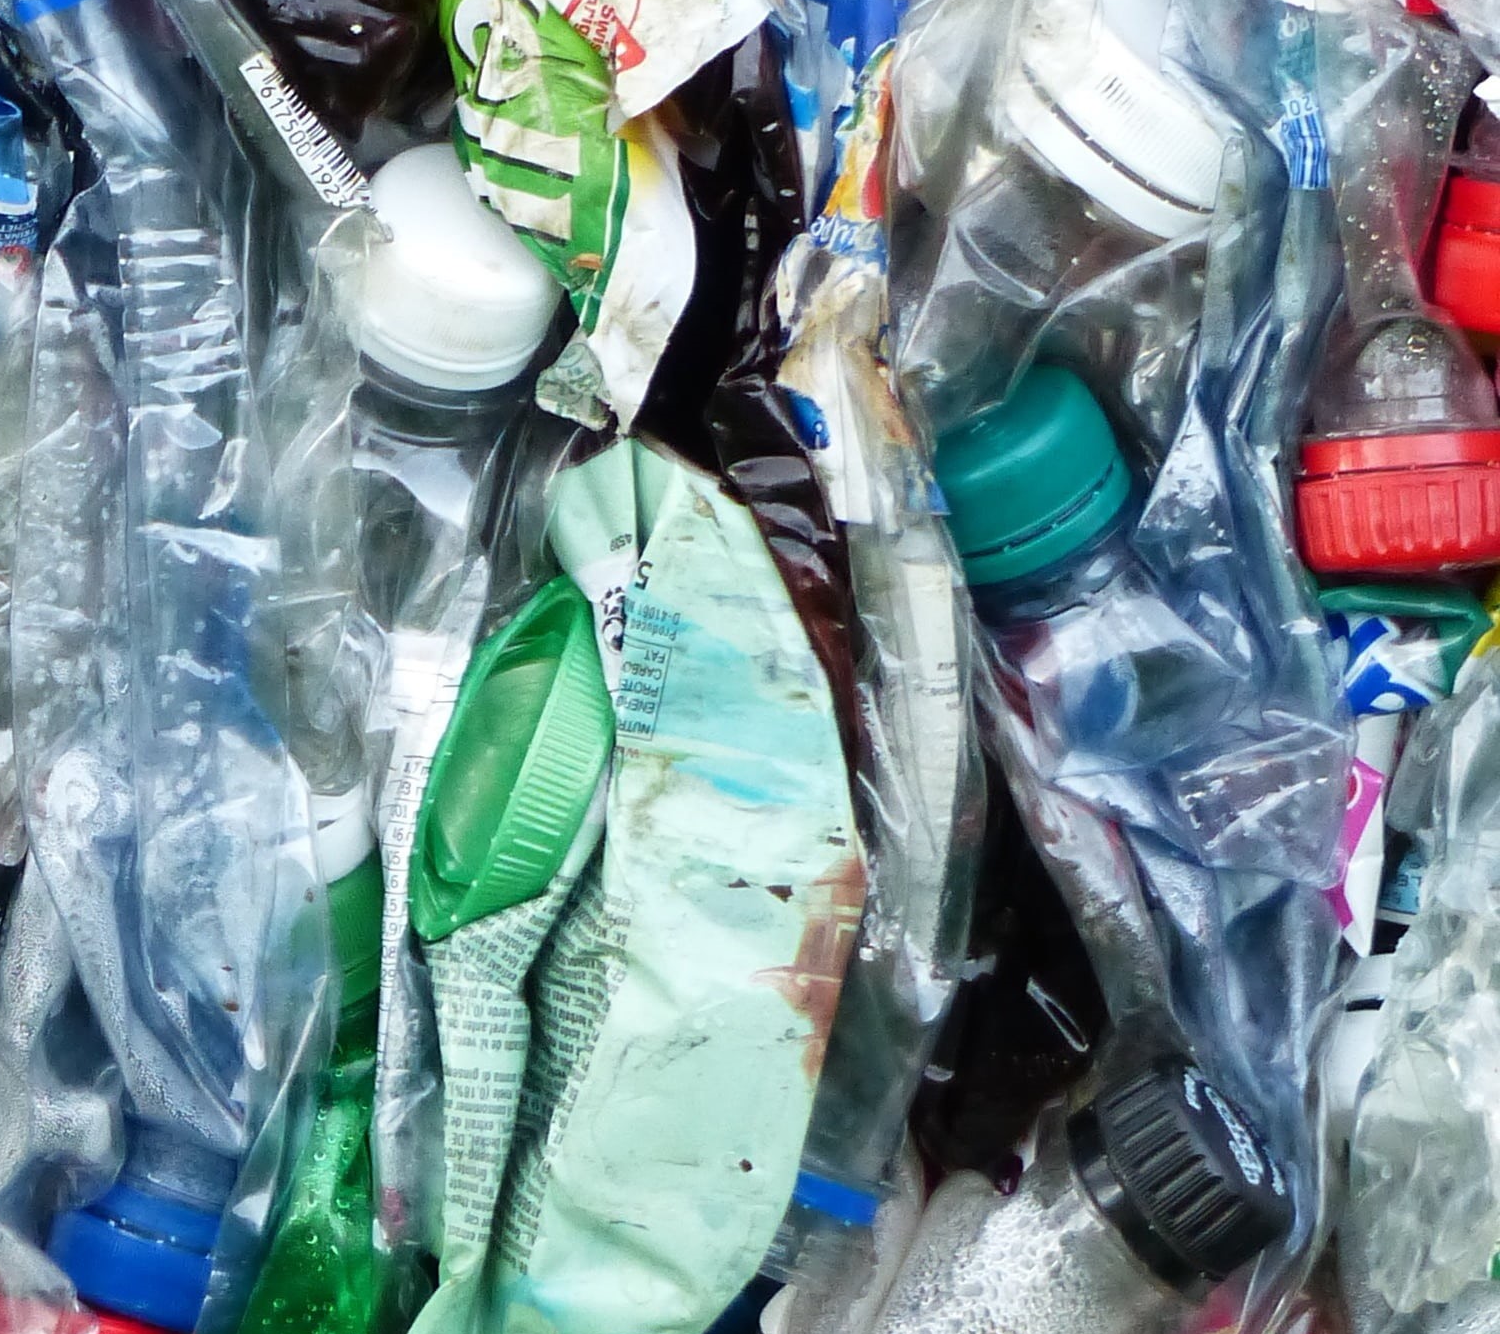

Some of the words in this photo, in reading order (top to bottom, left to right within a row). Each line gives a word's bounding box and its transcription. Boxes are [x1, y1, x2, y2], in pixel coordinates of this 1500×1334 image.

[246, 59, 265, 73] 7
[260, 86, 311, 157] 617500
[642, 647, 668, 663] FAT
